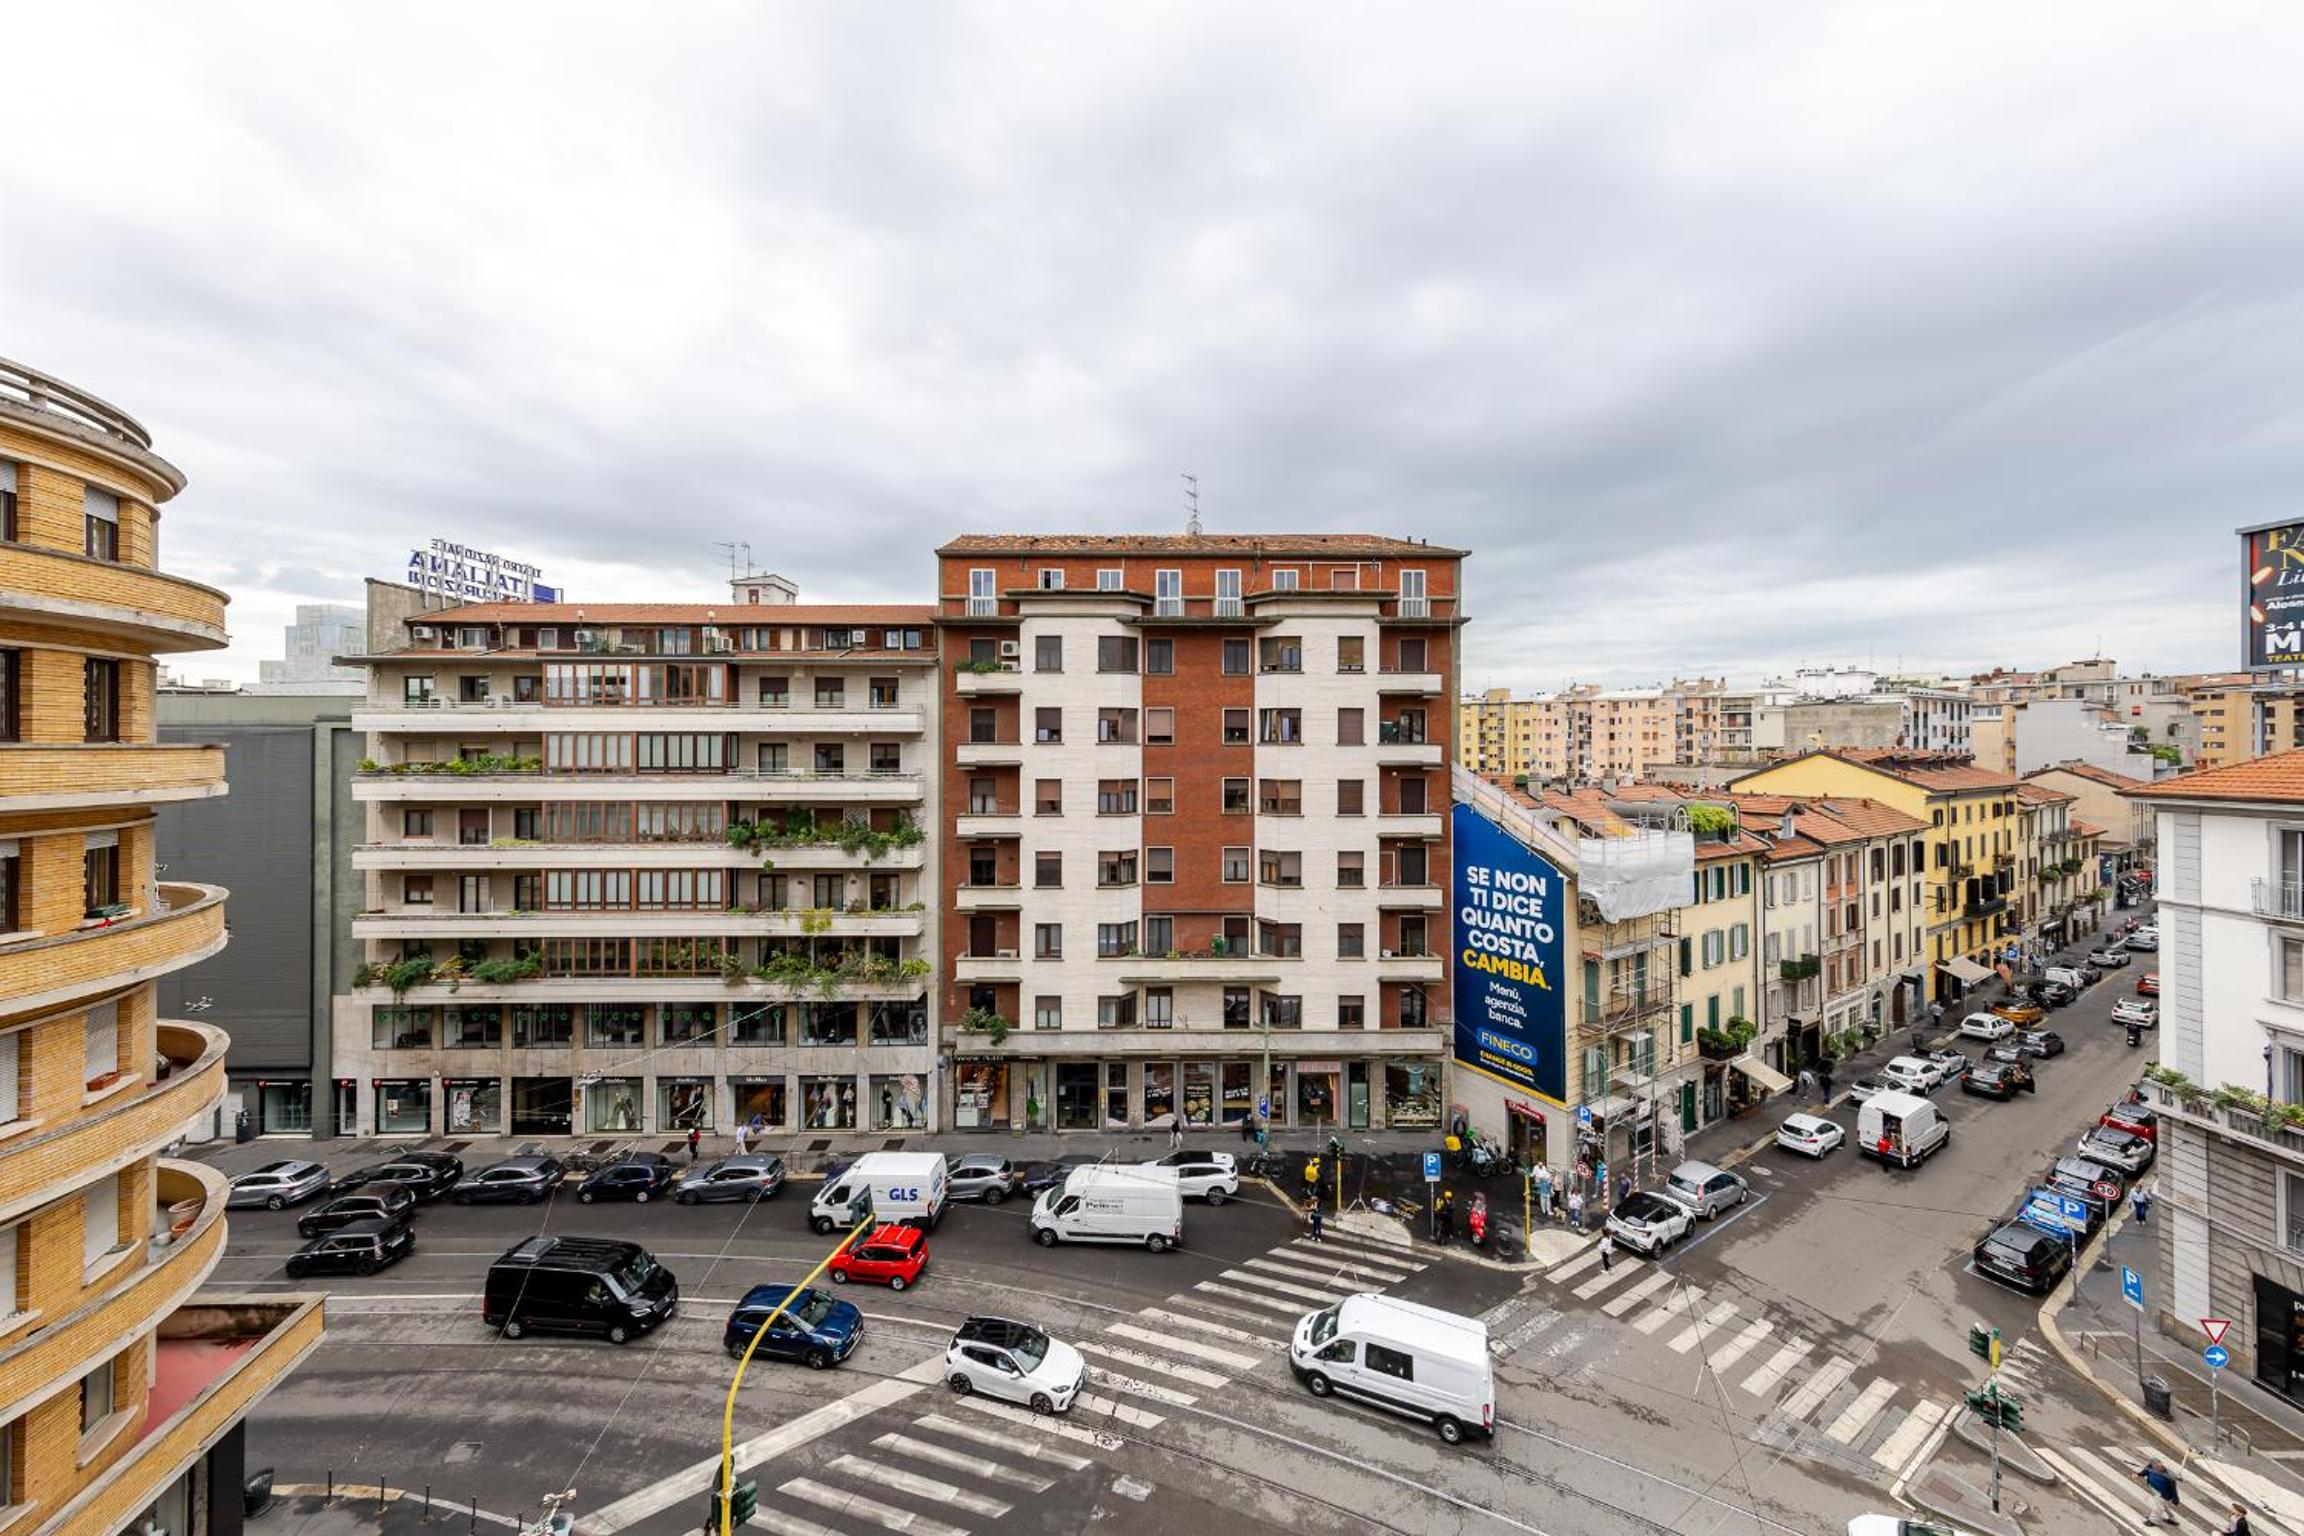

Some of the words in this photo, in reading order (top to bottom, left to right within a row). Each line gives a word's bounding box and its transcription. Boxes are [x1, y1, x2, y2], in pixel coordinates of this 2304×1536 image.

[1467, 865, 1490, 887] SE
[1495, 869, 1546, 897] NON
[1469, 886, 1488, 908] TI
[1492, 890, 1543, 919] DICE
[1461, 906, 1554, 944] QUANTO
[1468, 929, 1545, 968] COSTA,
[1462, 948, 1552, 991] CAMBIA.
[1485, 995, 1528, 1018] agenzia,
[1488, 1007, 1523, 1029] banca.
[1481, 1031, 1533, 1060] FINECO
[1580, 1105, 1588, 1118] P
[1426, 1154, 1437, 1167] P
[889, 1188, 918, 1202] GLS
[2101, 1187, 2113, 1196] 30
[2065, 1202, 2080, 1214] P
[2125, 1270, 2137, 1285] P
